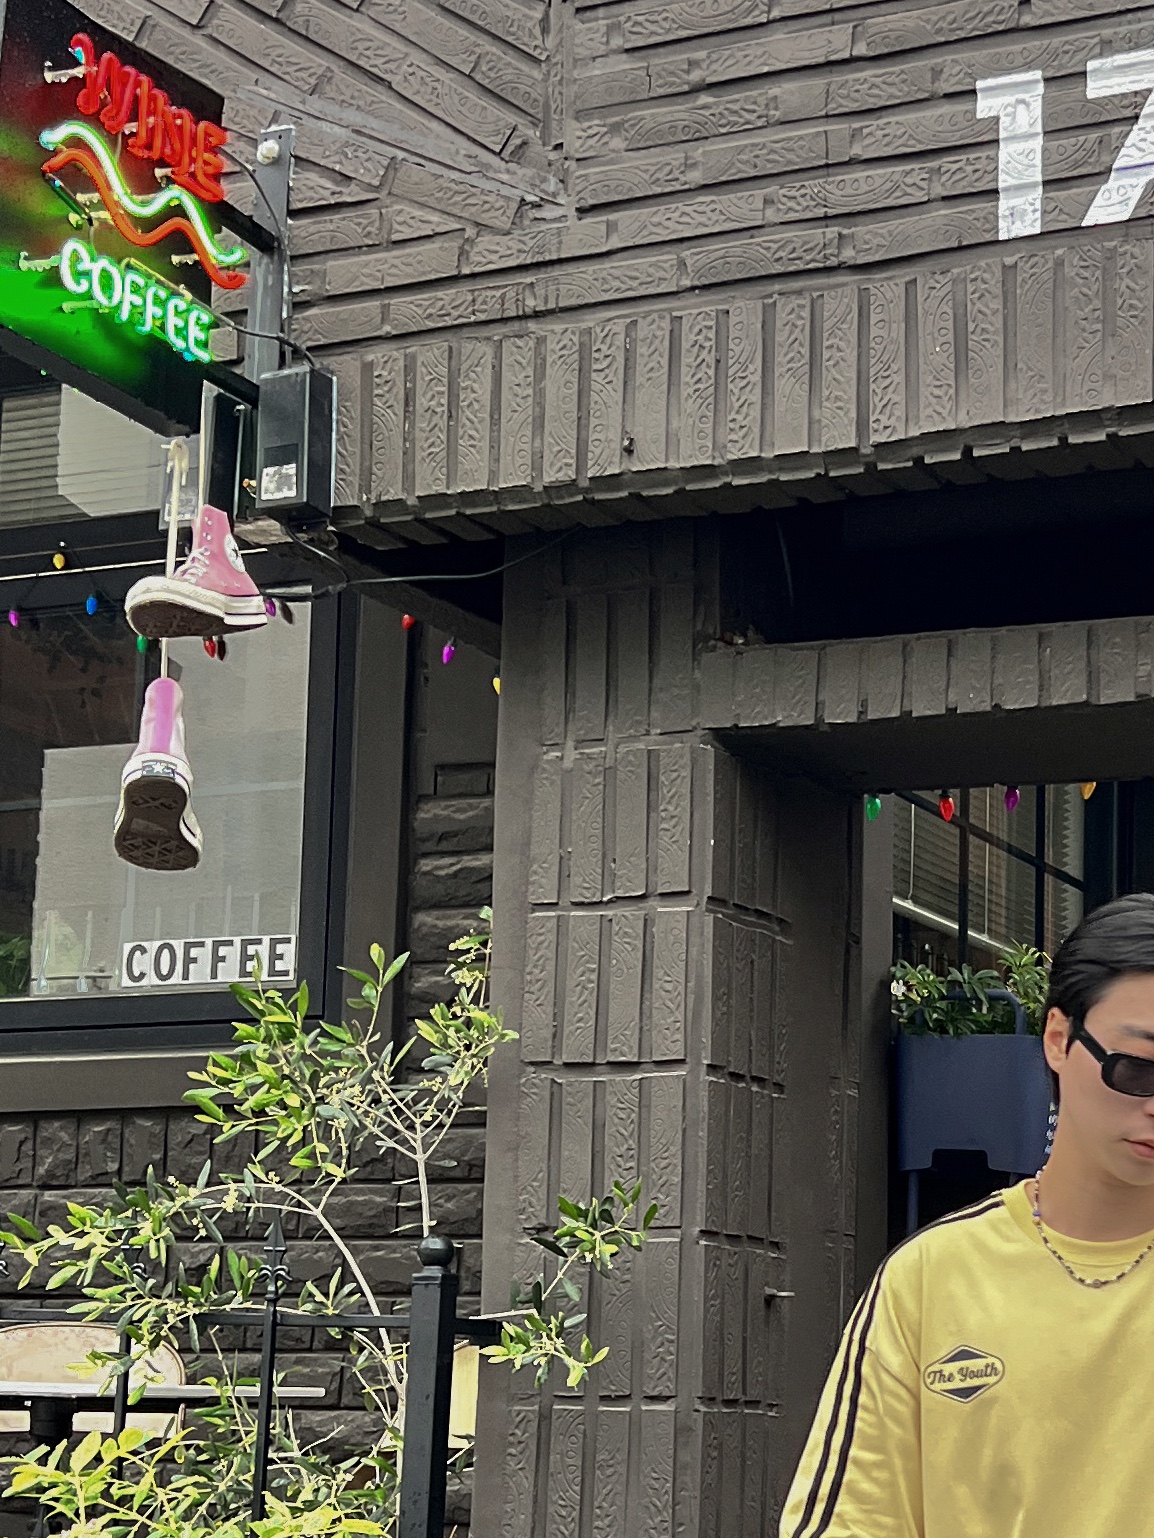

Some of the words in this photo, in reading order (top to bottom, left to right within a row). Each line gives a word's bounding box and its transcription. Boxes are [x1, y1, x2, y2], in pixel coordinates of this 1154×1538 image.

[59, 239, 214, 363] COFFEE
[126, 937, 292, 983] COFFEE
[927, 1368, 955, 1386] The
[957, 1361, 1000, 1382] Youth
